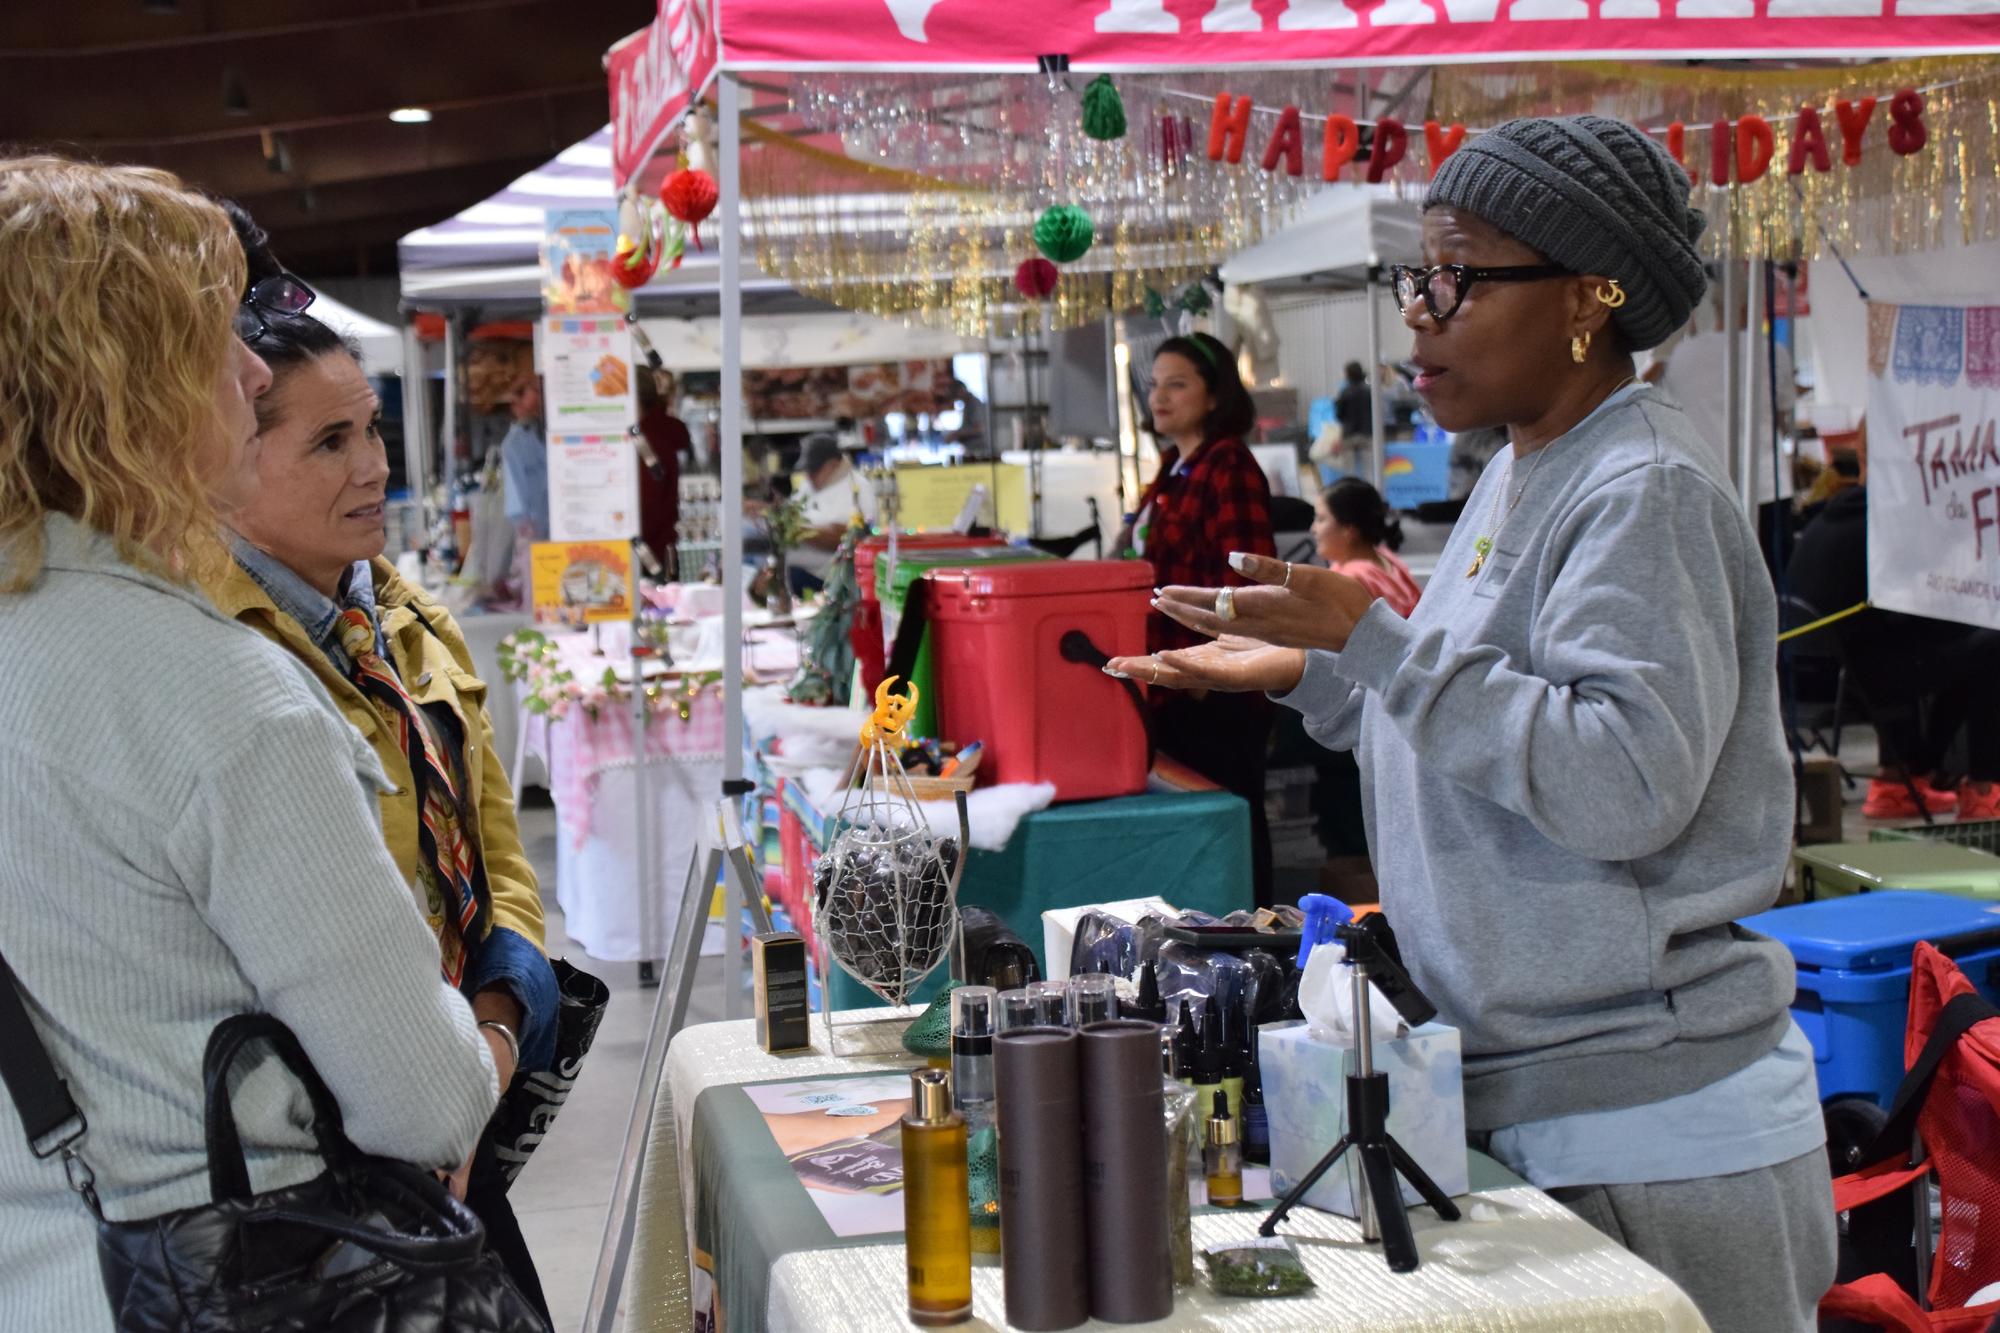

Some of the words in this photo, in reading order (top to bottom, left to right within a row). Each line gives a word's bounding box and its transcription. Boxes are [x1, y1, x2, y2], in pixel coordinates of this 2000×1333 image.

[1208, 91, 1467, 183] HAPPY
[1640, 87, 1927, 187] LIDAYS
[1945, 490, 1969, 520] de
[1971, 486, 2000, 561] F
